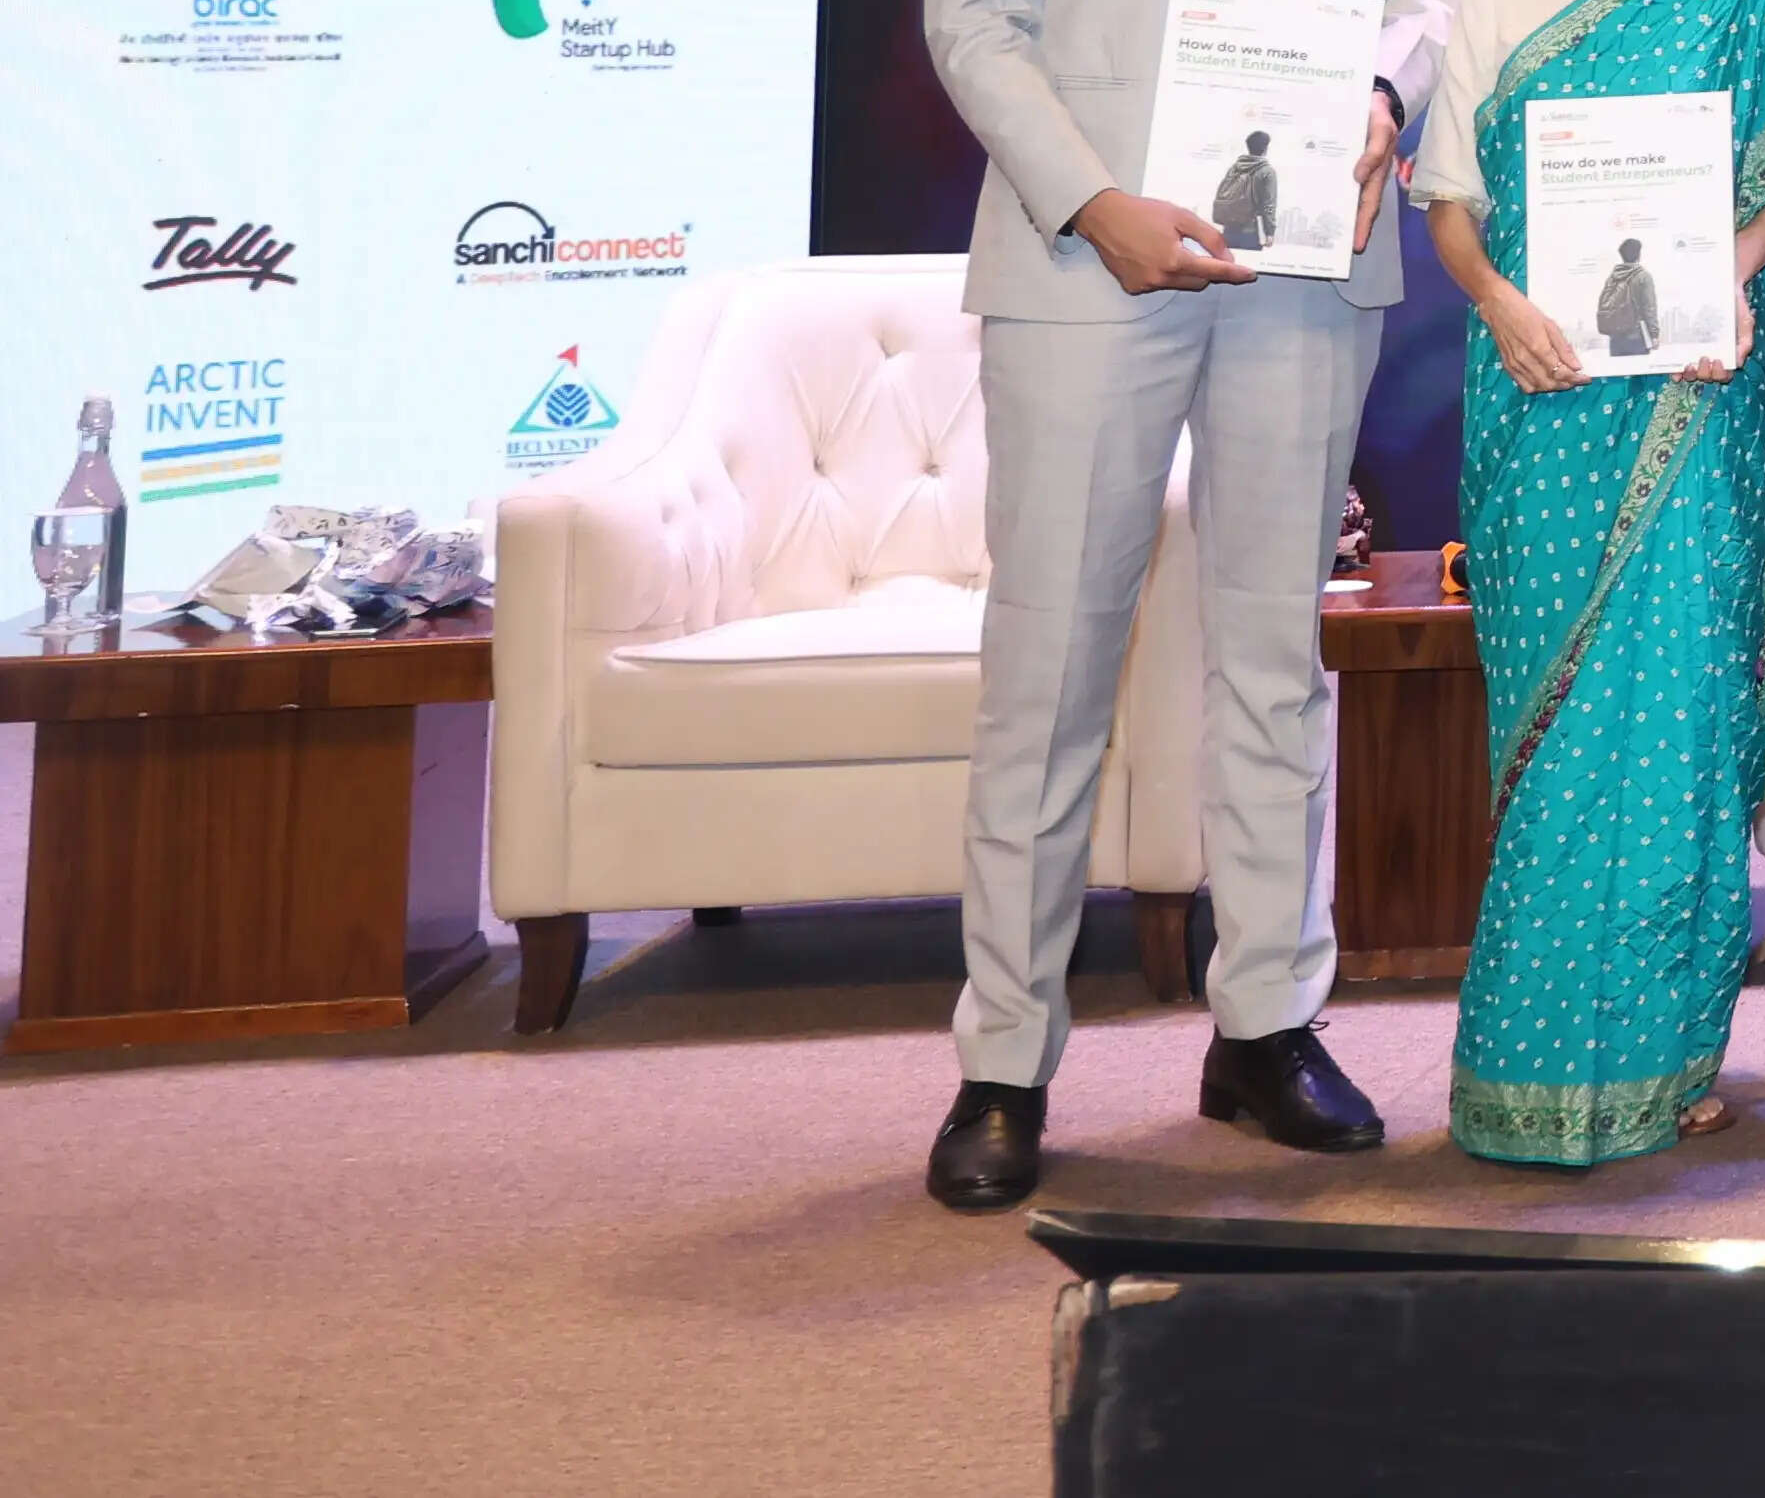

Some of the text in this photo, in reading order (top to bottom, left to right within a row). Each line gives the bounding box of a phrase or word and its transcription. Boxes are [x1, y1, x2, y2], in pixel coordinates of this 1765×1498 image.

[561, 17, 618, 36] MeitY
[560, 39, 676, 61] Startup Hub
[1179, 37, 1308, 61] How do we make
[1176, 51, 1236, 68] Student
[1541, 153, 1665, 171] How do we make
[1541, 169, 1598, 185] Student
[151, 215, 296, 291] Tally
[632, 264, 688, 278] Network
[145, 358, 285, 395] ARCTIC
[146, 396, 285, 432] INVENT
